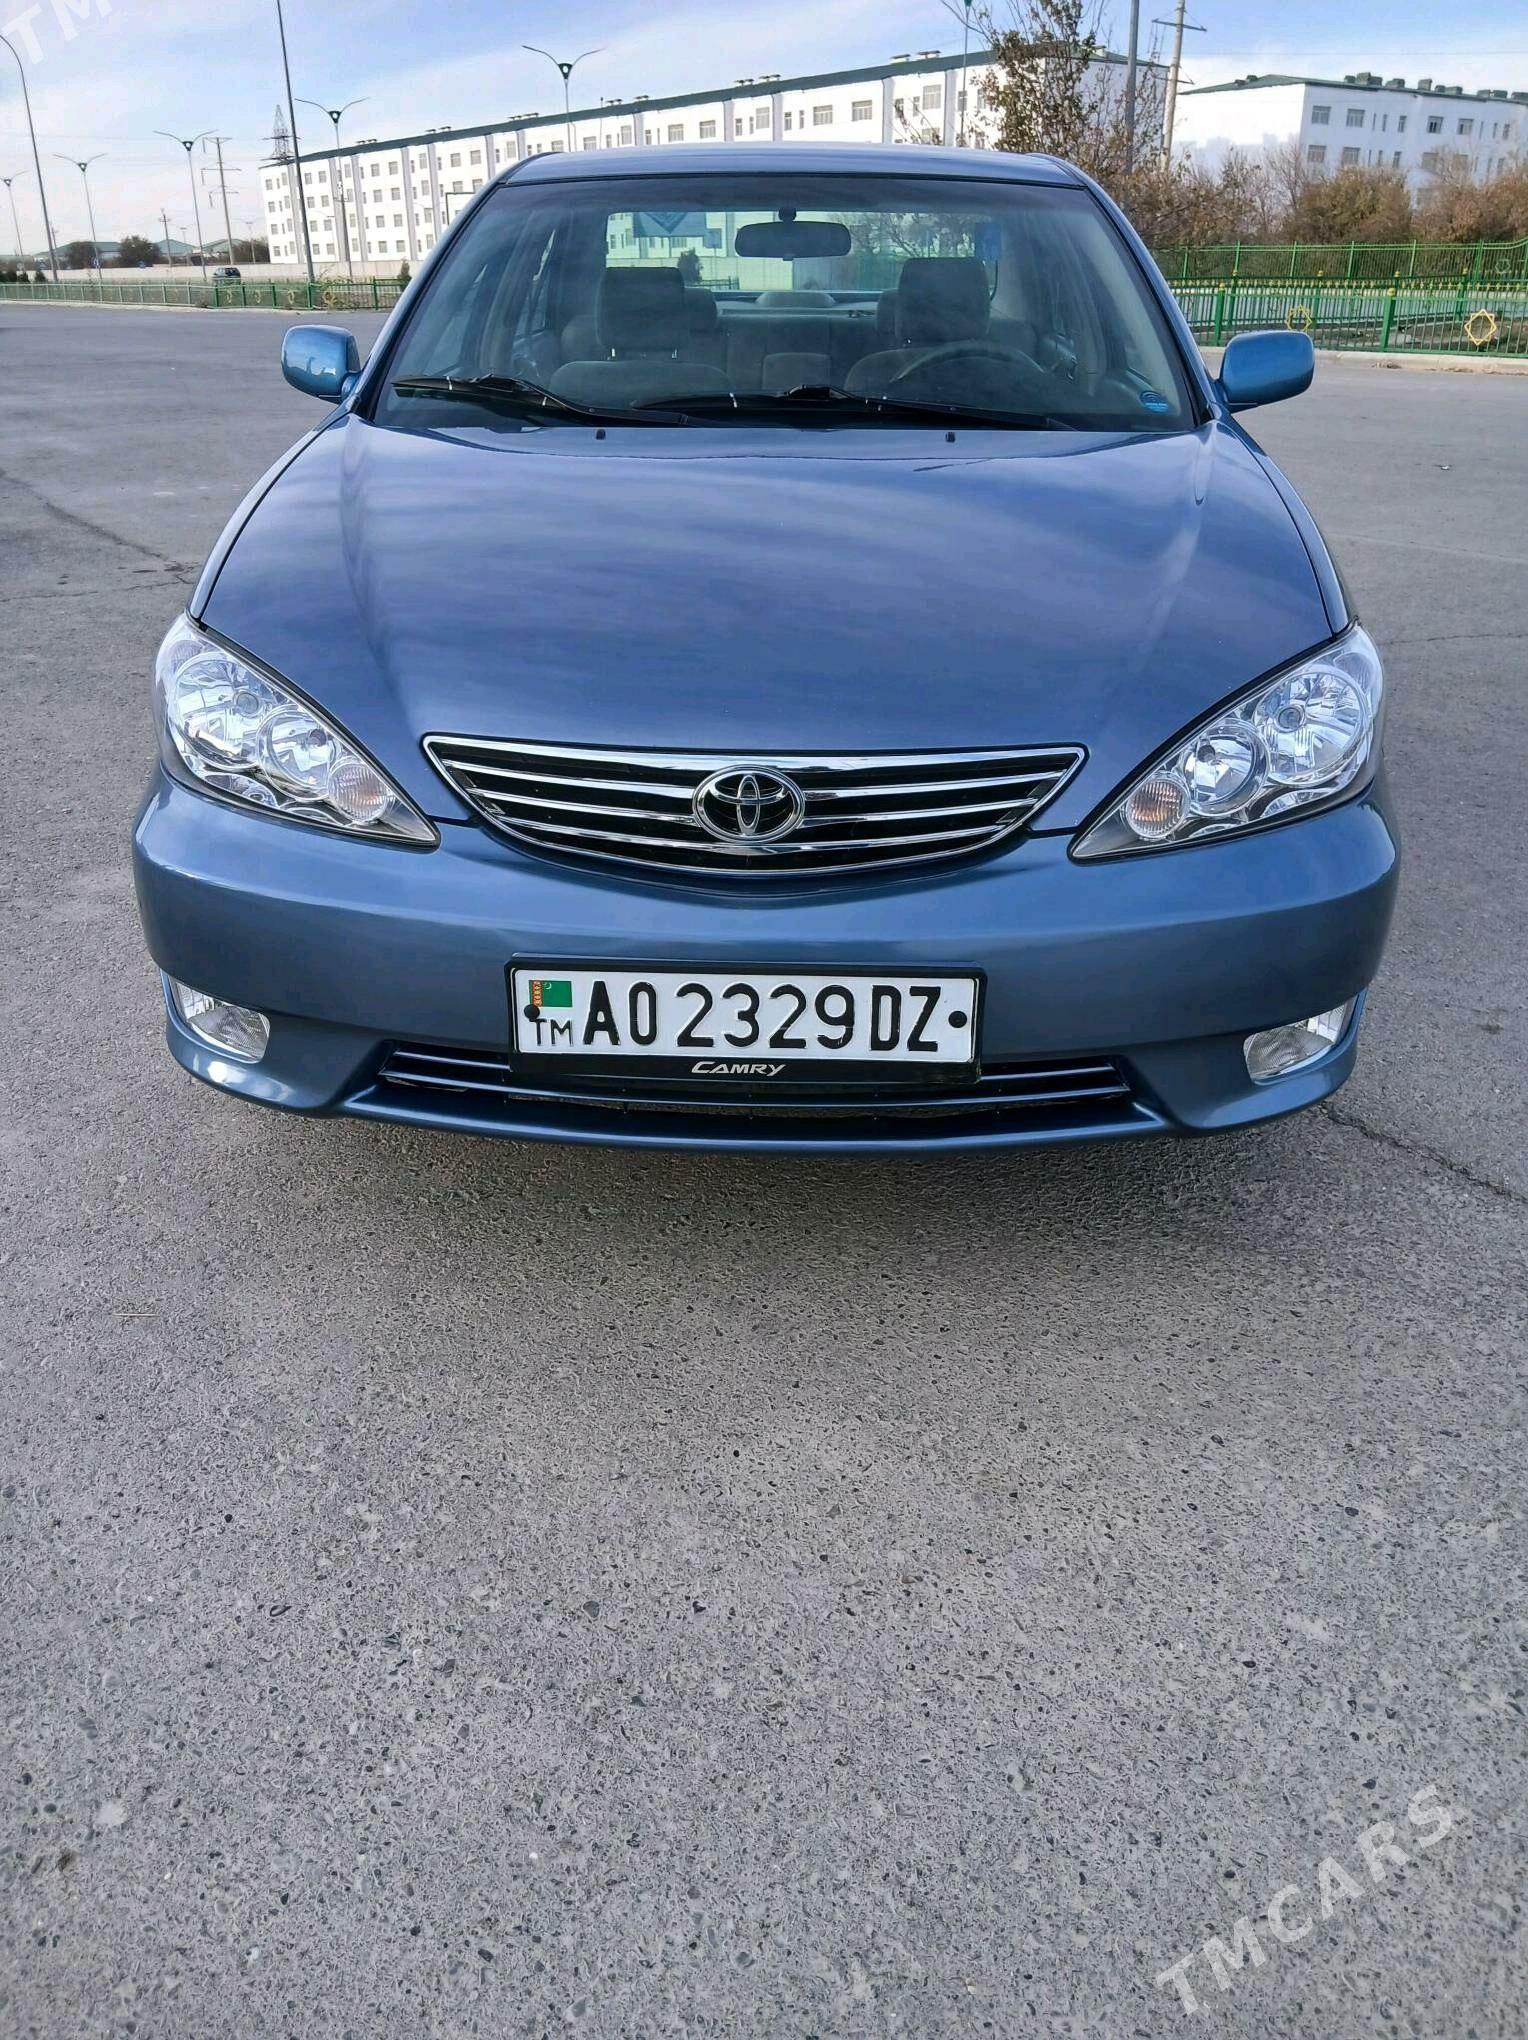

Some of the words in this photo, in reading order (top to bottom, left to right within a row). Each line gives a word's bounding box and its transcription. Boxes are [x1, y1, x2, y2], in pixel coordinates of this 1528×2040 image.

[528, 1017, 573, 1046] TM
[675, 982, 855, 1049] 2329
[870, 984, 941, 1052] DZ
[691, 1061, 786, 1077] CAMRY
